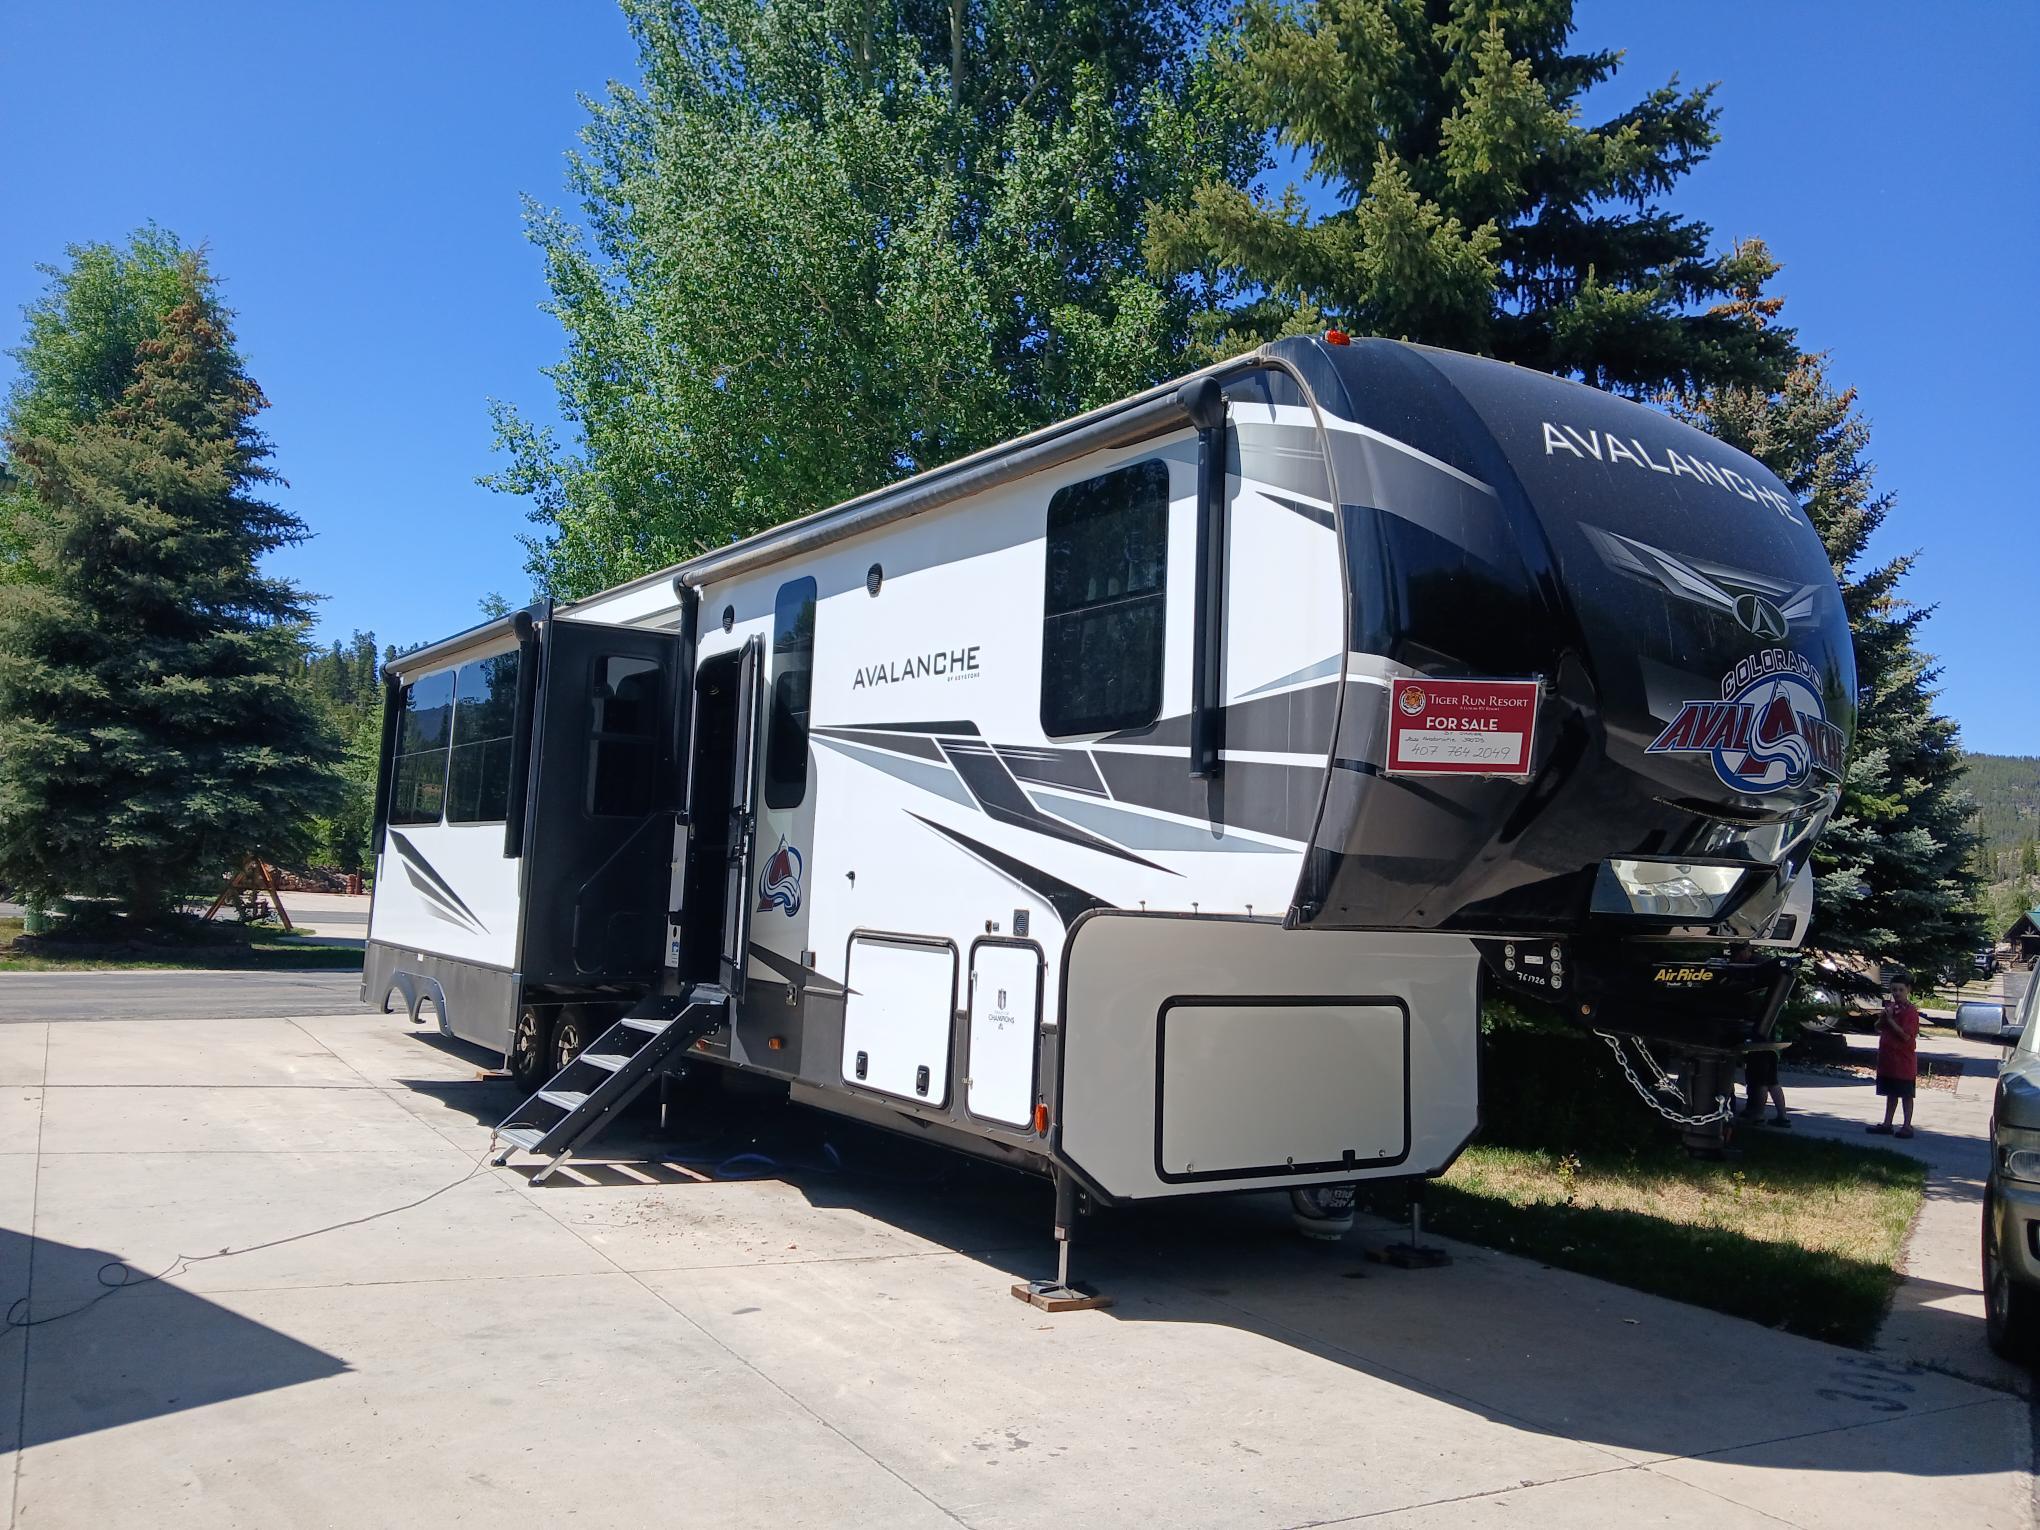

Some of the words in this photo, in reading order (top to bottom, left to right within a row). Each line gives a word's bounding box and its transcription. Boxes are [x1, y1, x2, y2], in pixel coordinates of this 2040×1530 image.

[1542, 421, 1803, 527] AVALANCHE
[852, 645, 981, 690] AVALANCHE
[1721, 648, 1824, 701] COLORADO
[1426, 716, 1457, 730] FOR
[1460, 718, 1499, 731] SALE
[1411, 744, 1439, 757] 407
[1448, 745, 1470, 757] 764
[1473, 746, 1511, 760] 2049
